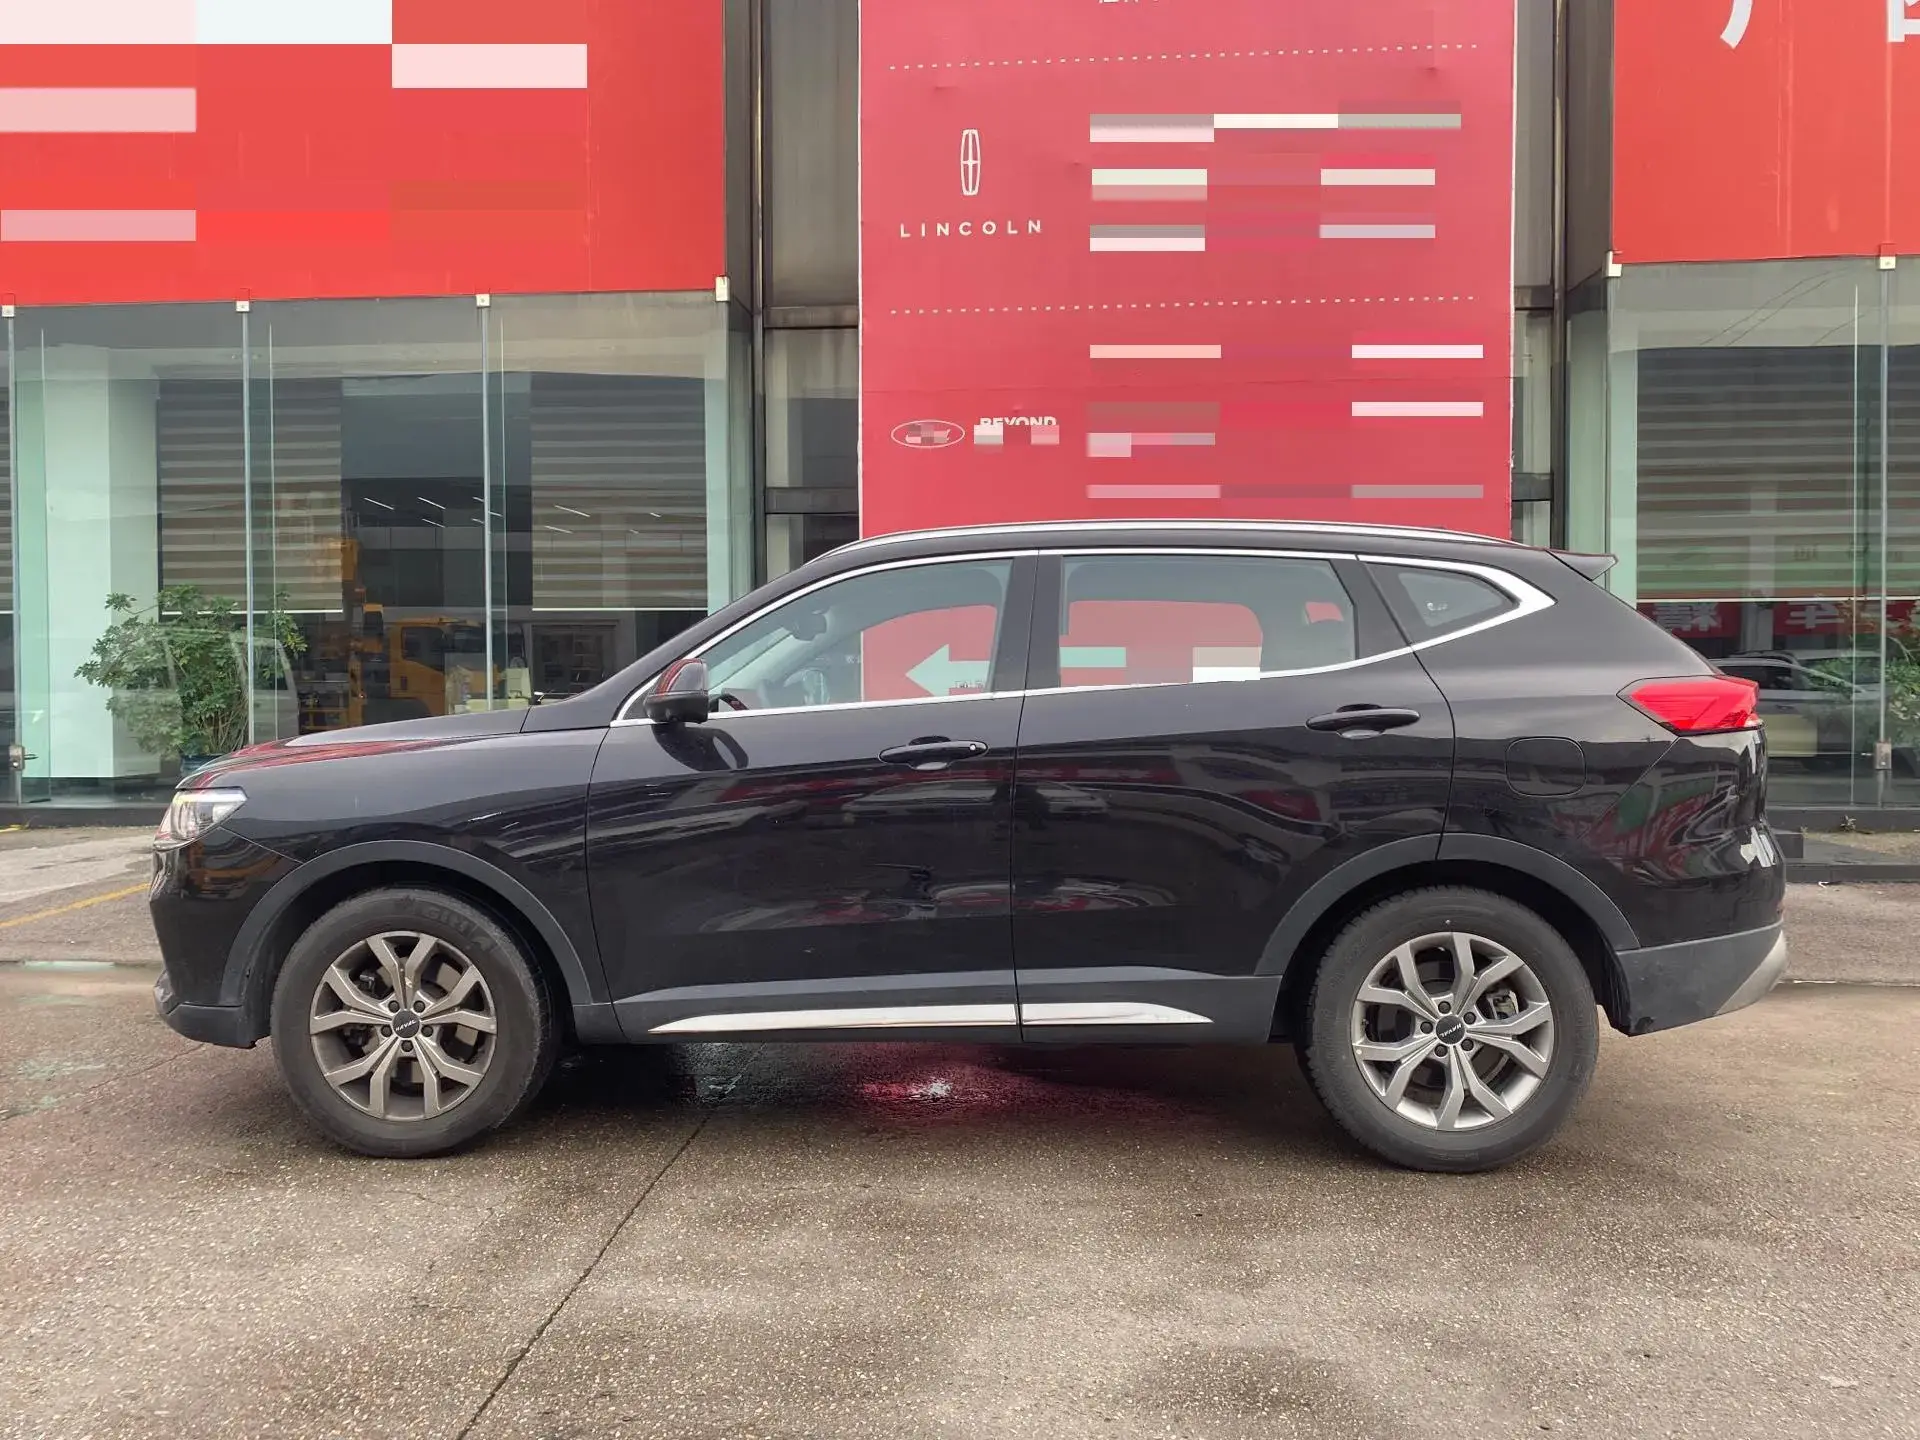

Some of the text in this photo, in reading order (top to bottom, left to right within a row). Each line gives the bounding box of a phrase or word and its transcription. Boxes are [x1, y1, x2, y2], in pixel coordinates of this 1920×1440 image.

[900, 219, 1042, 238] LINCOLN
[395, 1019, 417, 1032] HAVAL
[1440, 1023, 1462, 1038] HAVAL
